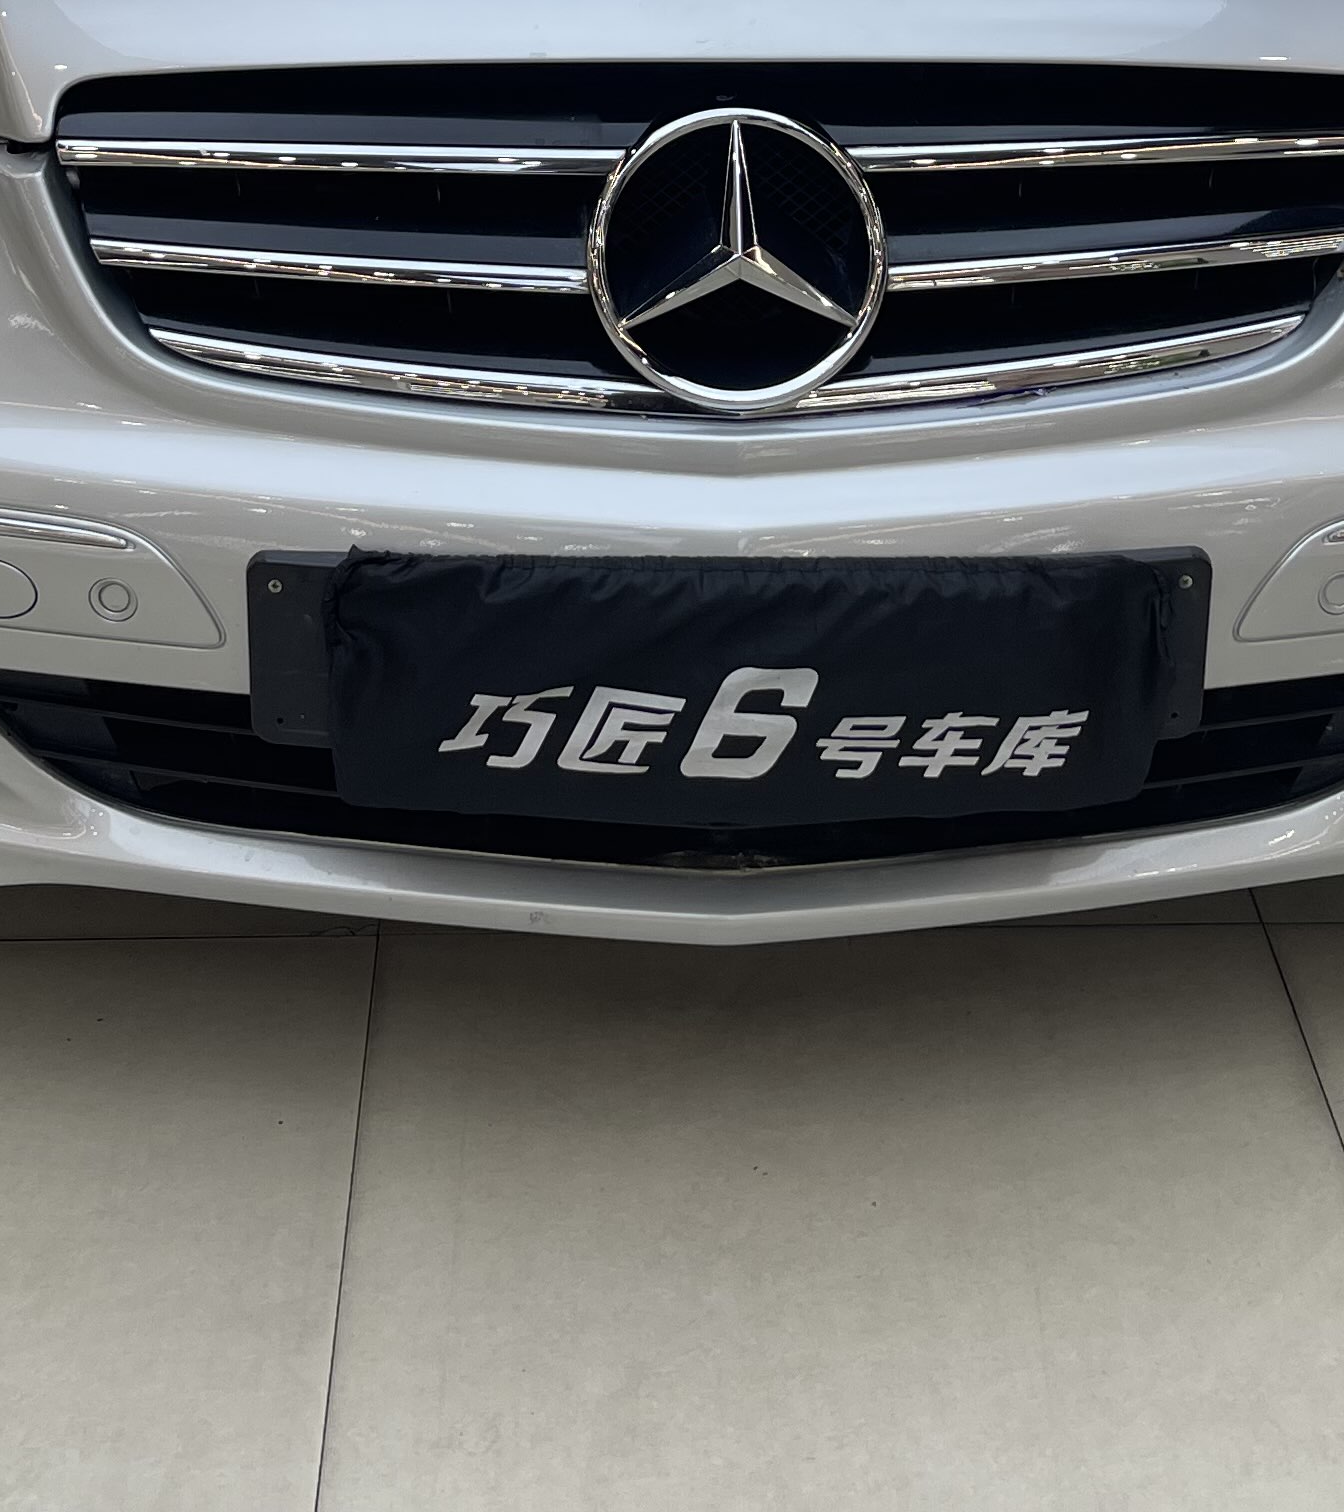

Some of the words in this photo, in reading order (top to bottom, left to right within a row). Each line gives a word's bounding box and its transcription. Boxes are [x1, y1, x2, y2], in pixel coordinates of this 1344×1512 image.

[438, 666, 1089, 779] 巧匠6号车库
